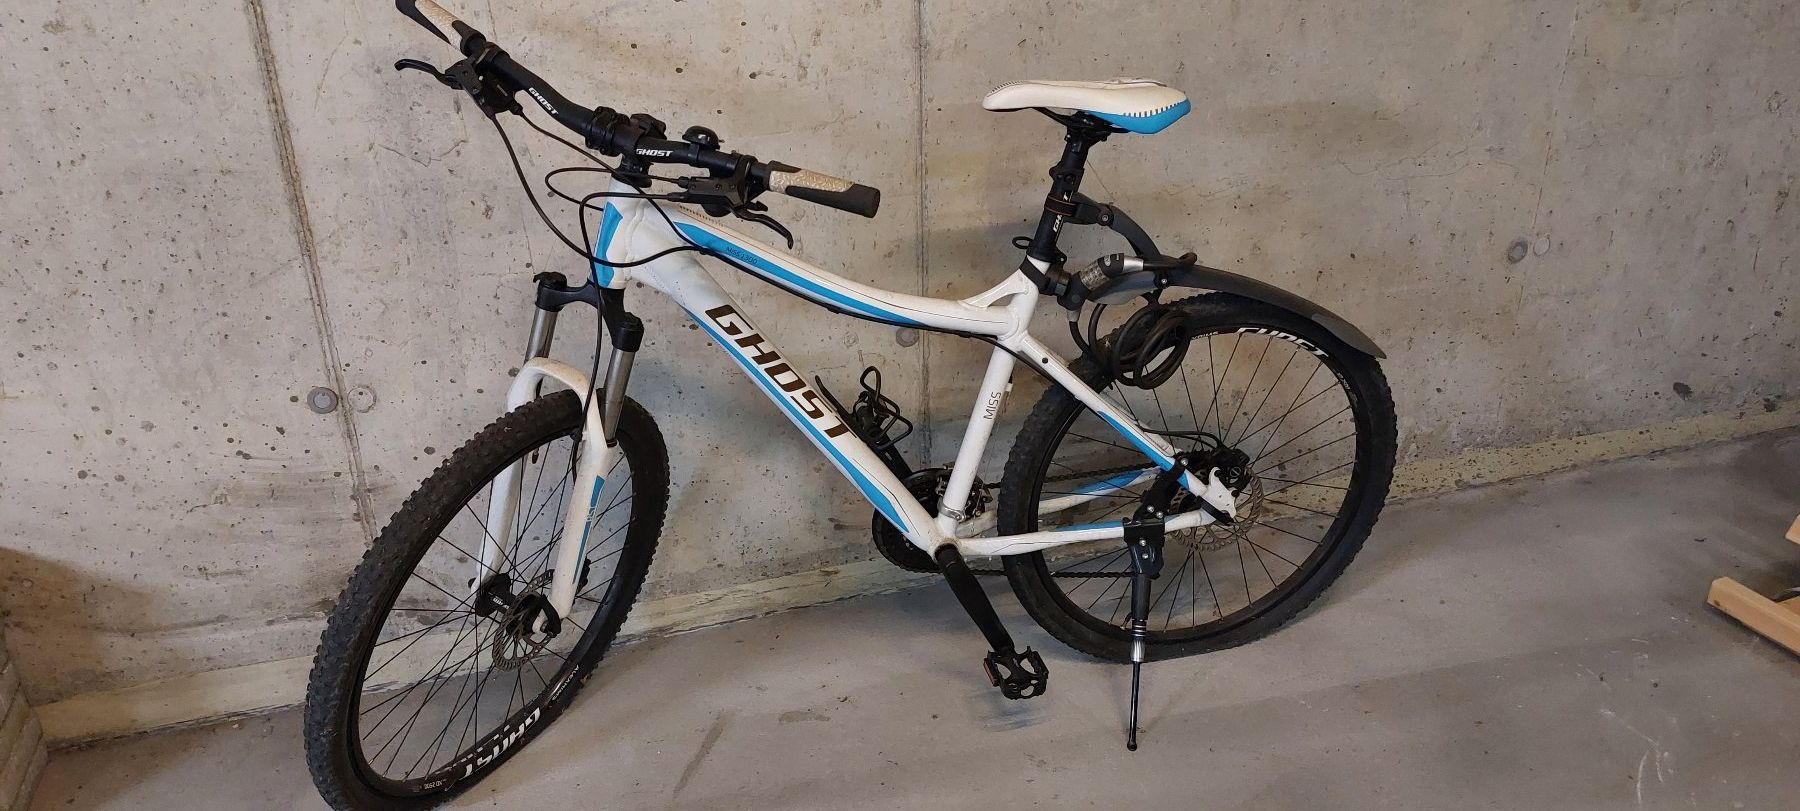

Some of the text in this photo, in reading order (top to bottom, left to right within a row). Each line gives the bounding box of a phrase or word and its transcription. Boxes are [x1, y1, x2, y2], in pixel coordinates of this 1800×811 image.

[528, 87, 559, 115] GHOST
[635, 148, 673, 157] GHOST
[705, 304, 857, 438] GHOST
[983, 391, 1002, 420] MISS
